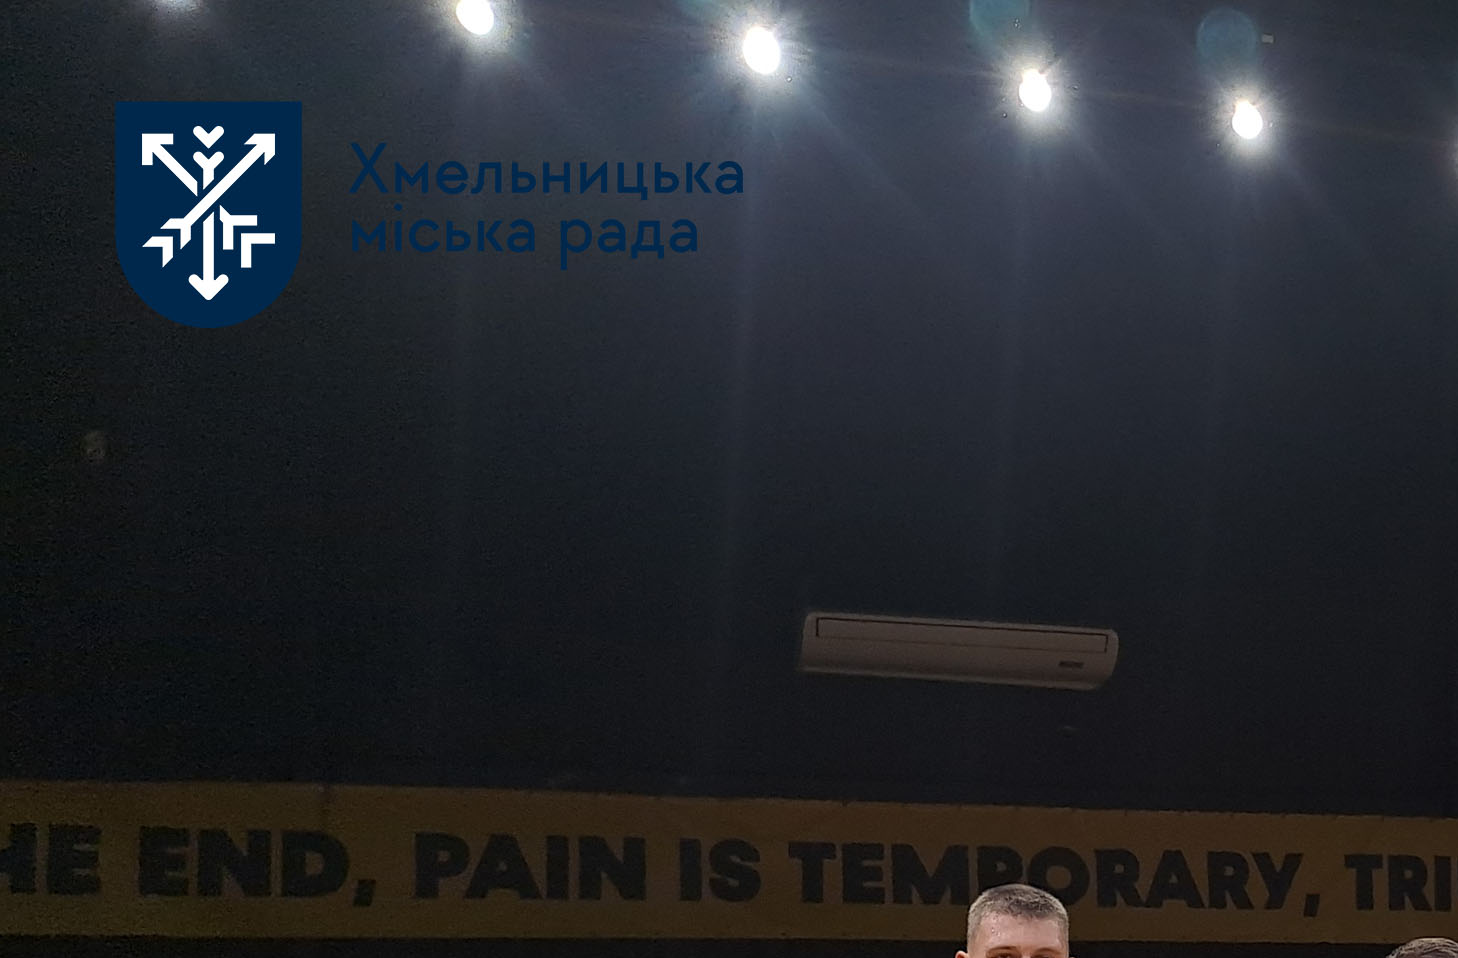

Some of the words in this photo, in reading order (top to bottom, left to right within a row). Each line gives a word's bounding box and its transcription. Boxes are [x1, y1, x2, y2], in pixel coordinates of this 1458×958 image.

[139, 826, 376, 907] END,
[415, 832, 646, 900] PAIN
[679, 837, 762, 902] IS
[788, 841, 1320, 918] TEMPORARY,
